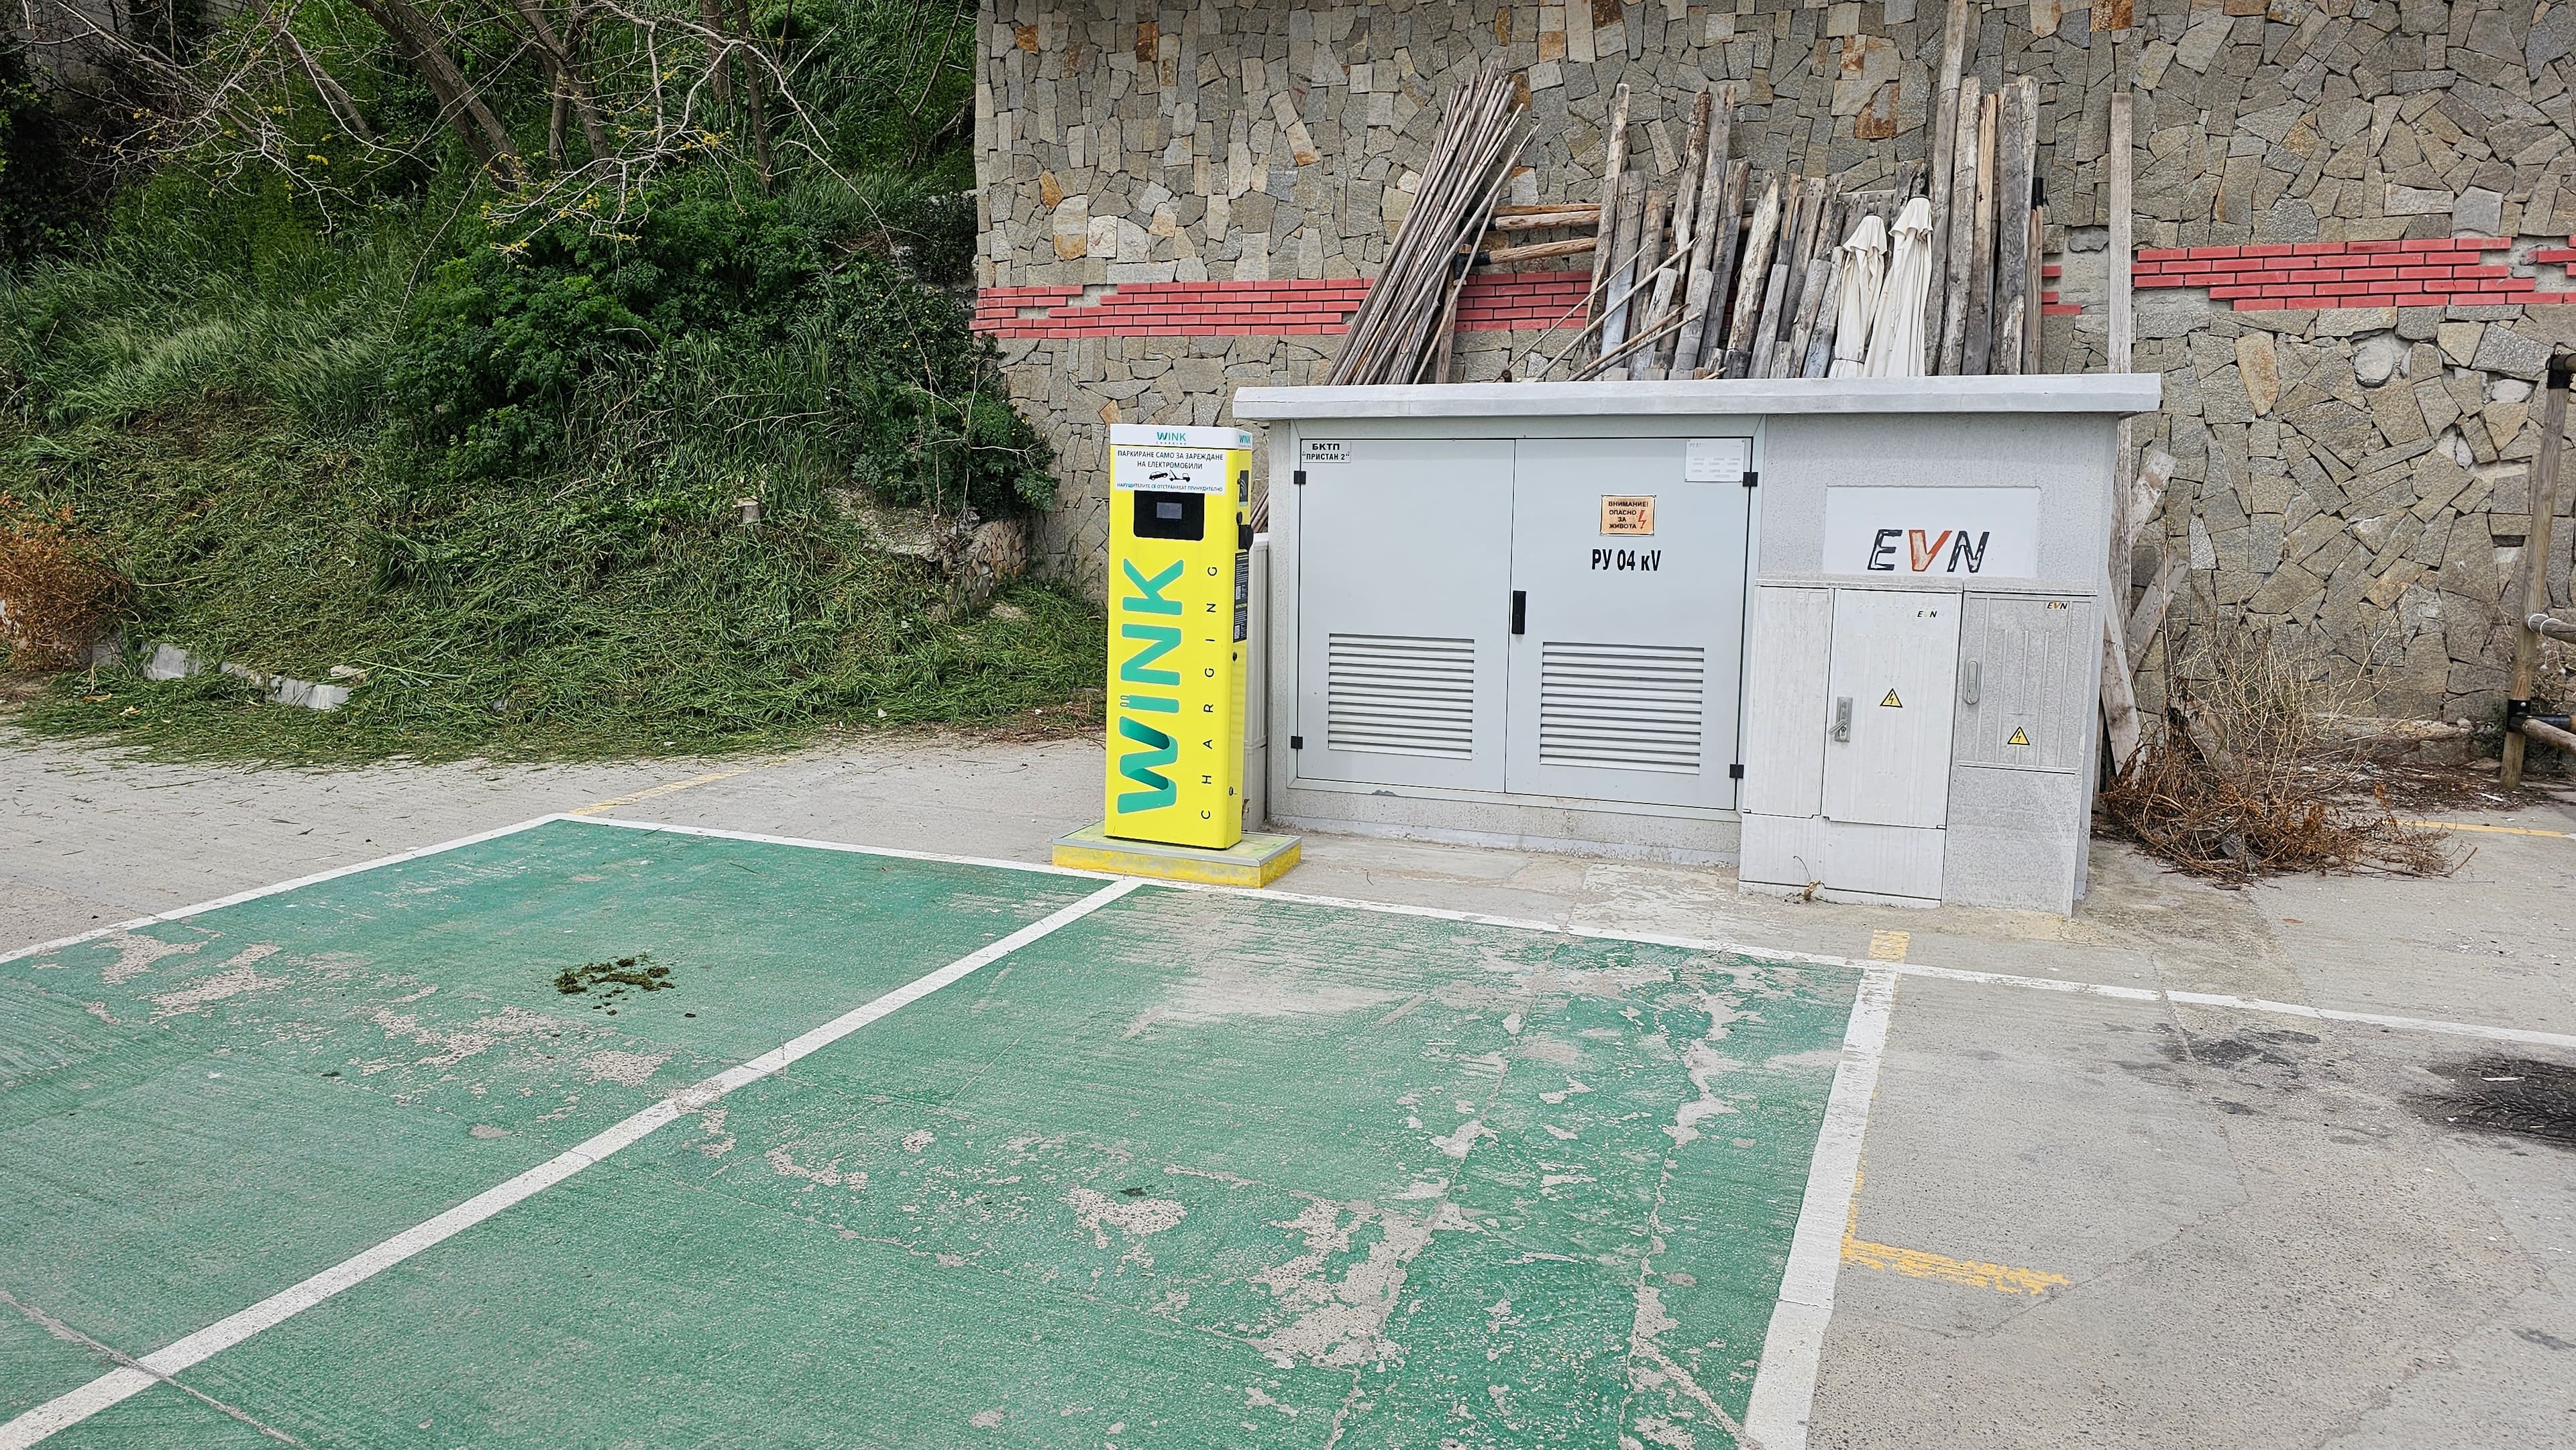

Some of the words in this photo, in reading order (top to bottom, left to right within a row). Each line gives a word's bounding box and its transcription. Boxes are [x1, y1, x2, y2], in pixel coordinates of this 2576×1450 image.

[1157, 431, 1186, 441] WINK
[1118, 450, 1155, 458] ПАРКИРАНЕ
[1185, 453, 1224, 461] ЗАРЕЖДАНЕ
[1148, 461, 1203, 469] ЕЛЕКТРОМОБИЛИ
[1867, 528, 1990, 573] EVN
[1591, 549, 1613, 571] РУ
[1617, 549, 1635, 571] 04
[2047, 602, 2068, 610] EVN
[1117, 557, 1185, 815] WINK
[1200, 565, 1218, 820] CHARGING
